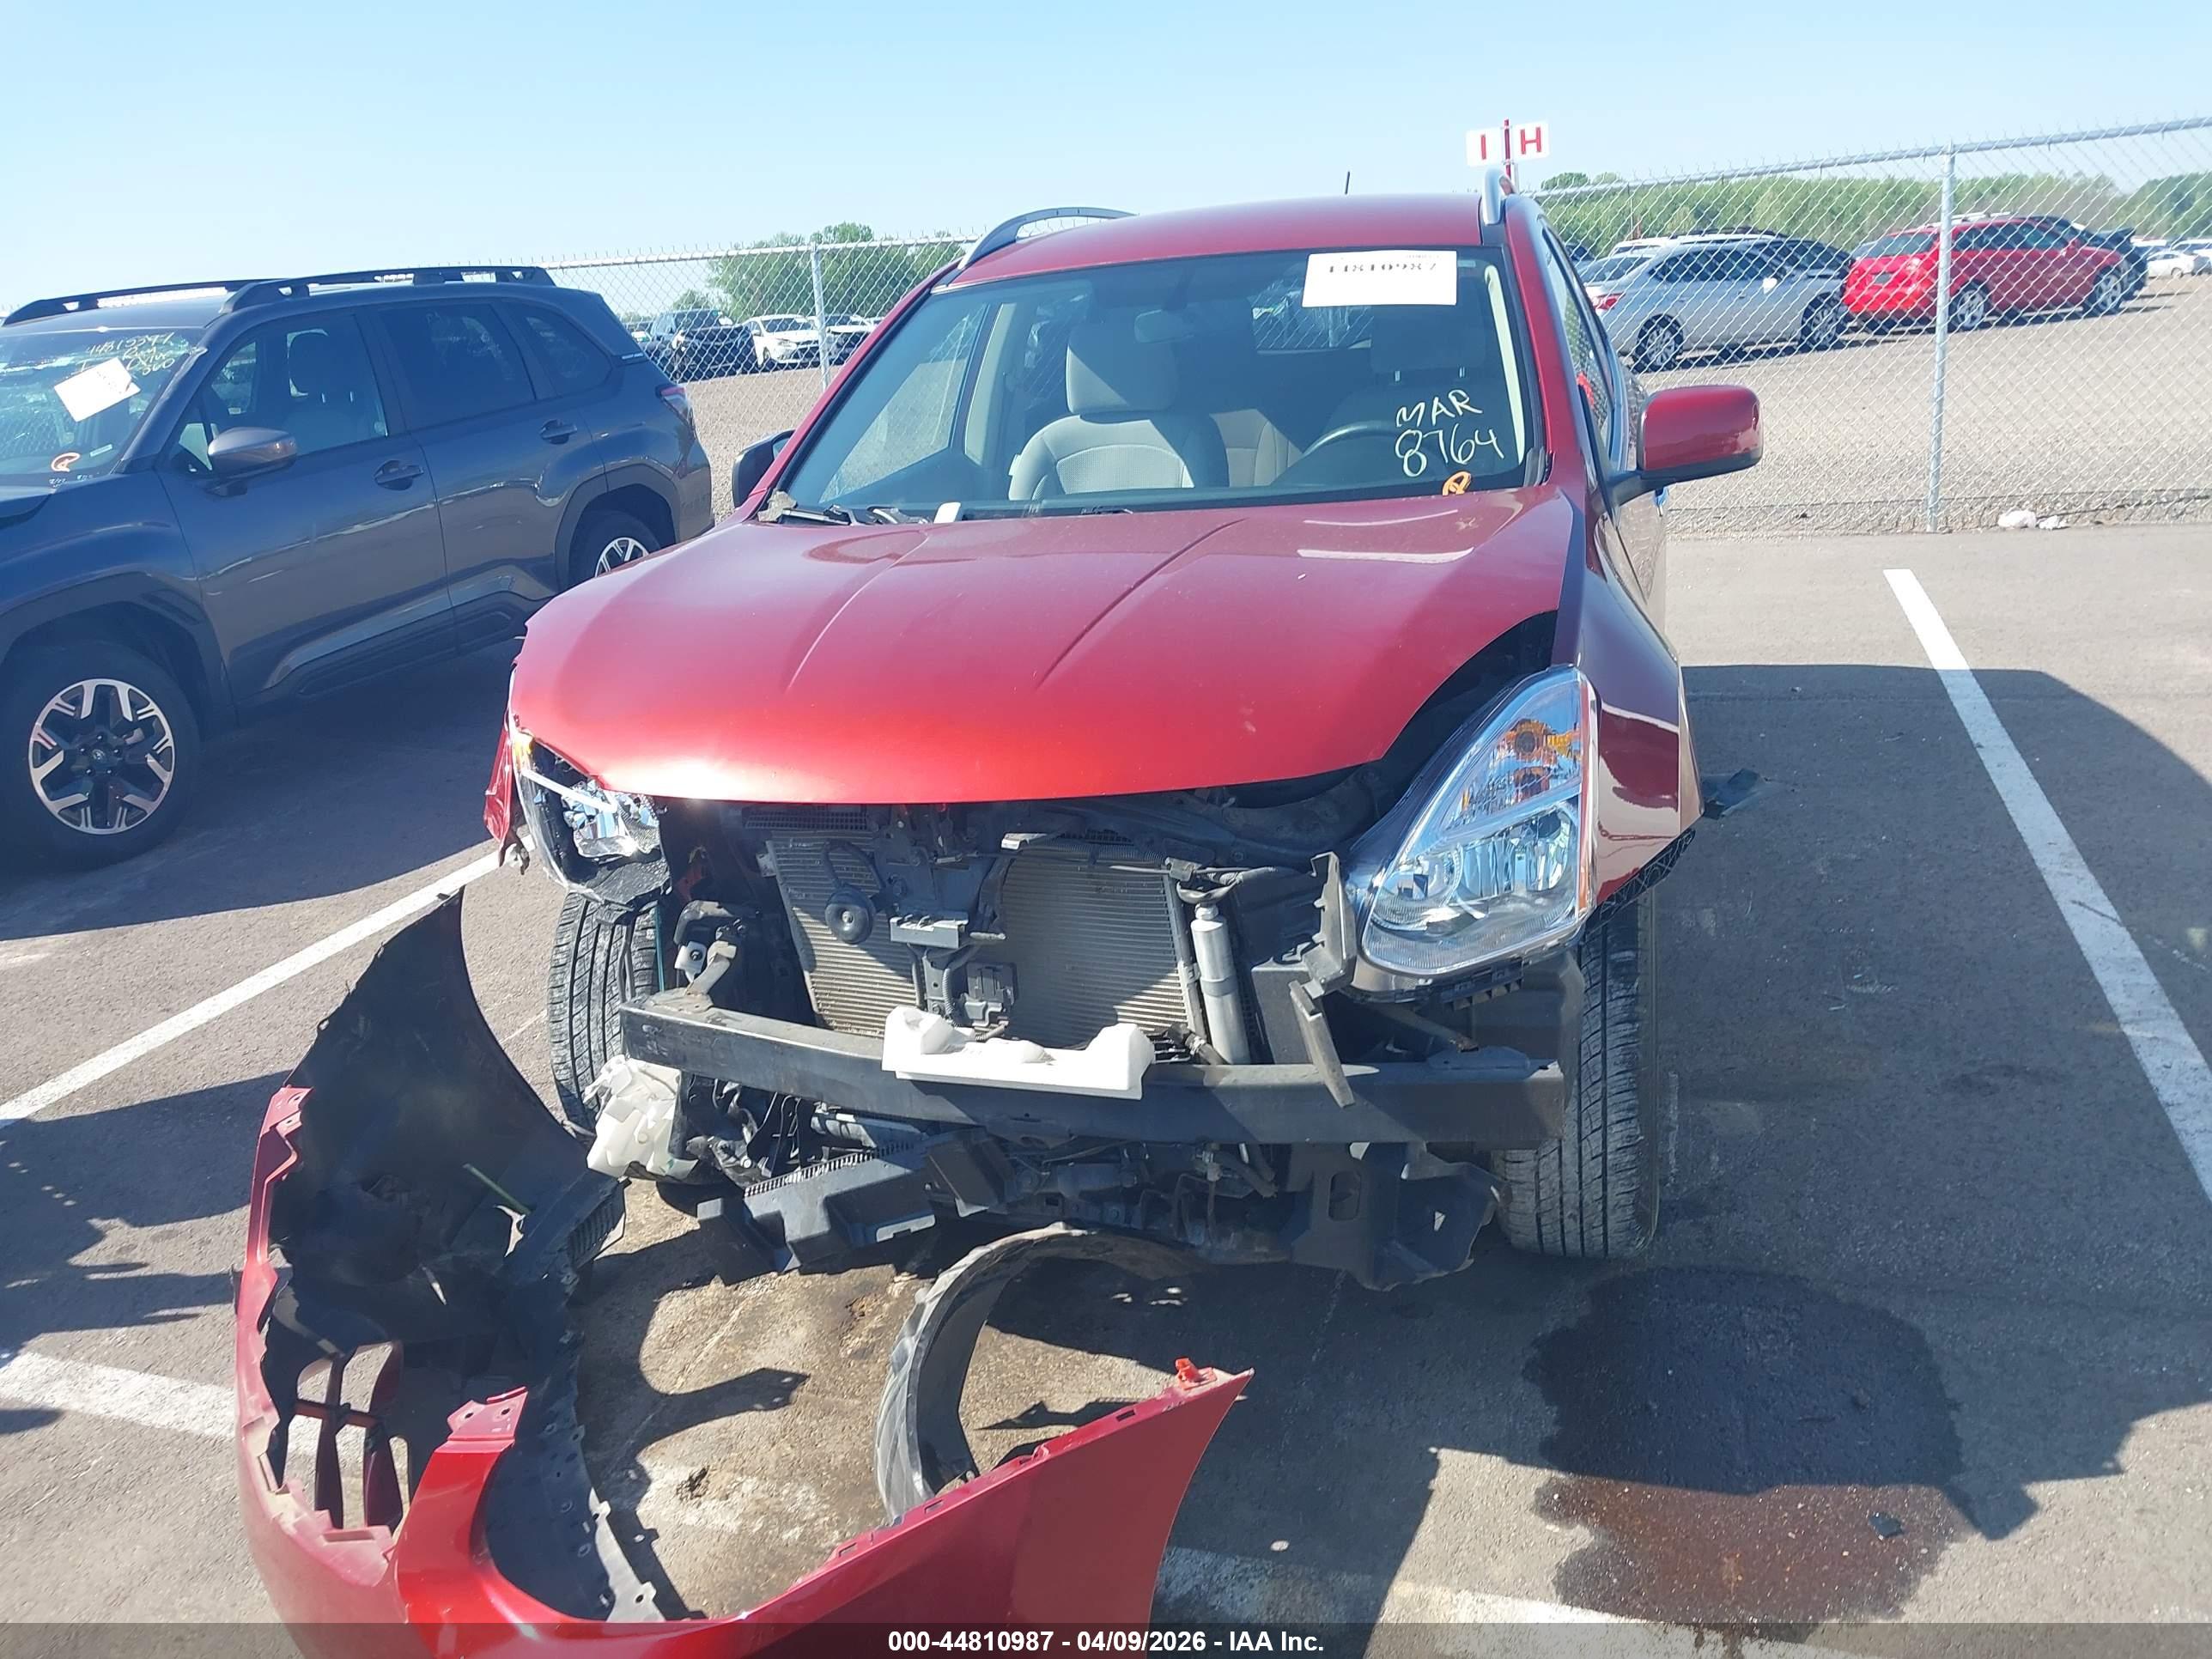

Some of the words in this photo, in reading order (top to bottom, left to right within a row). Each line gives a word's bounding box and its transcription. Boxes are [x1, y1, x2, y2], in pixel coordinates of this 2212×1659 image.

[1520, 126, 1542, 155] H
[1395, 389, 1484, 428] MAR
[1395, 422, 1505, 477] 8764
